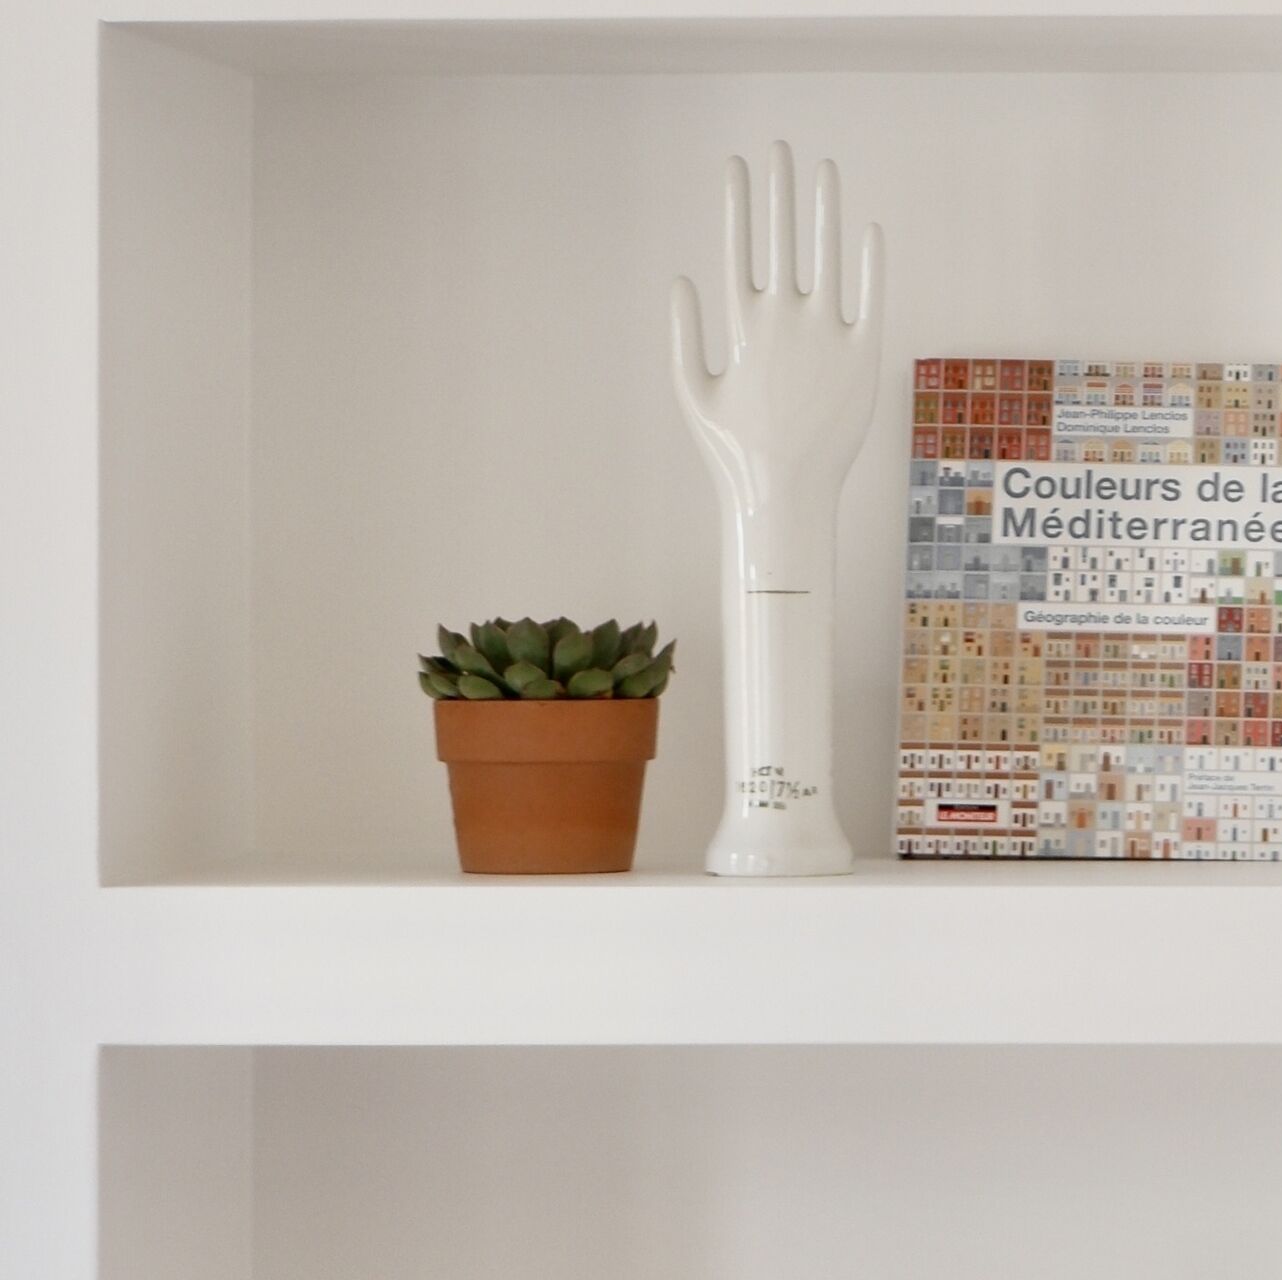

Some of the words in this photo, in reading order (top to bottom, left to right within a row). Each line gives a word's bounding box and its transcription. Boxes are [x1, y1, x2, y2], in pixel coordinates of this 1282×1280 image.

[1057, 408, 1138, 420] Jean-Philippe
[1141, 410, 1189, 421] Lenclos
[1056, 421, 1120, 434] Dominique
[1124, 423, 1170, 434] Lenclos
[1002, 467, 1182, 501] Couleurs
[1196, 471, 1245, 503] de
[1023, 610, 1110, 626] Géographie
[1113, 612, 1132, 624] de
[1136, 612, 1149, 625] la
[1153, 613, 1209, 626] couleur
